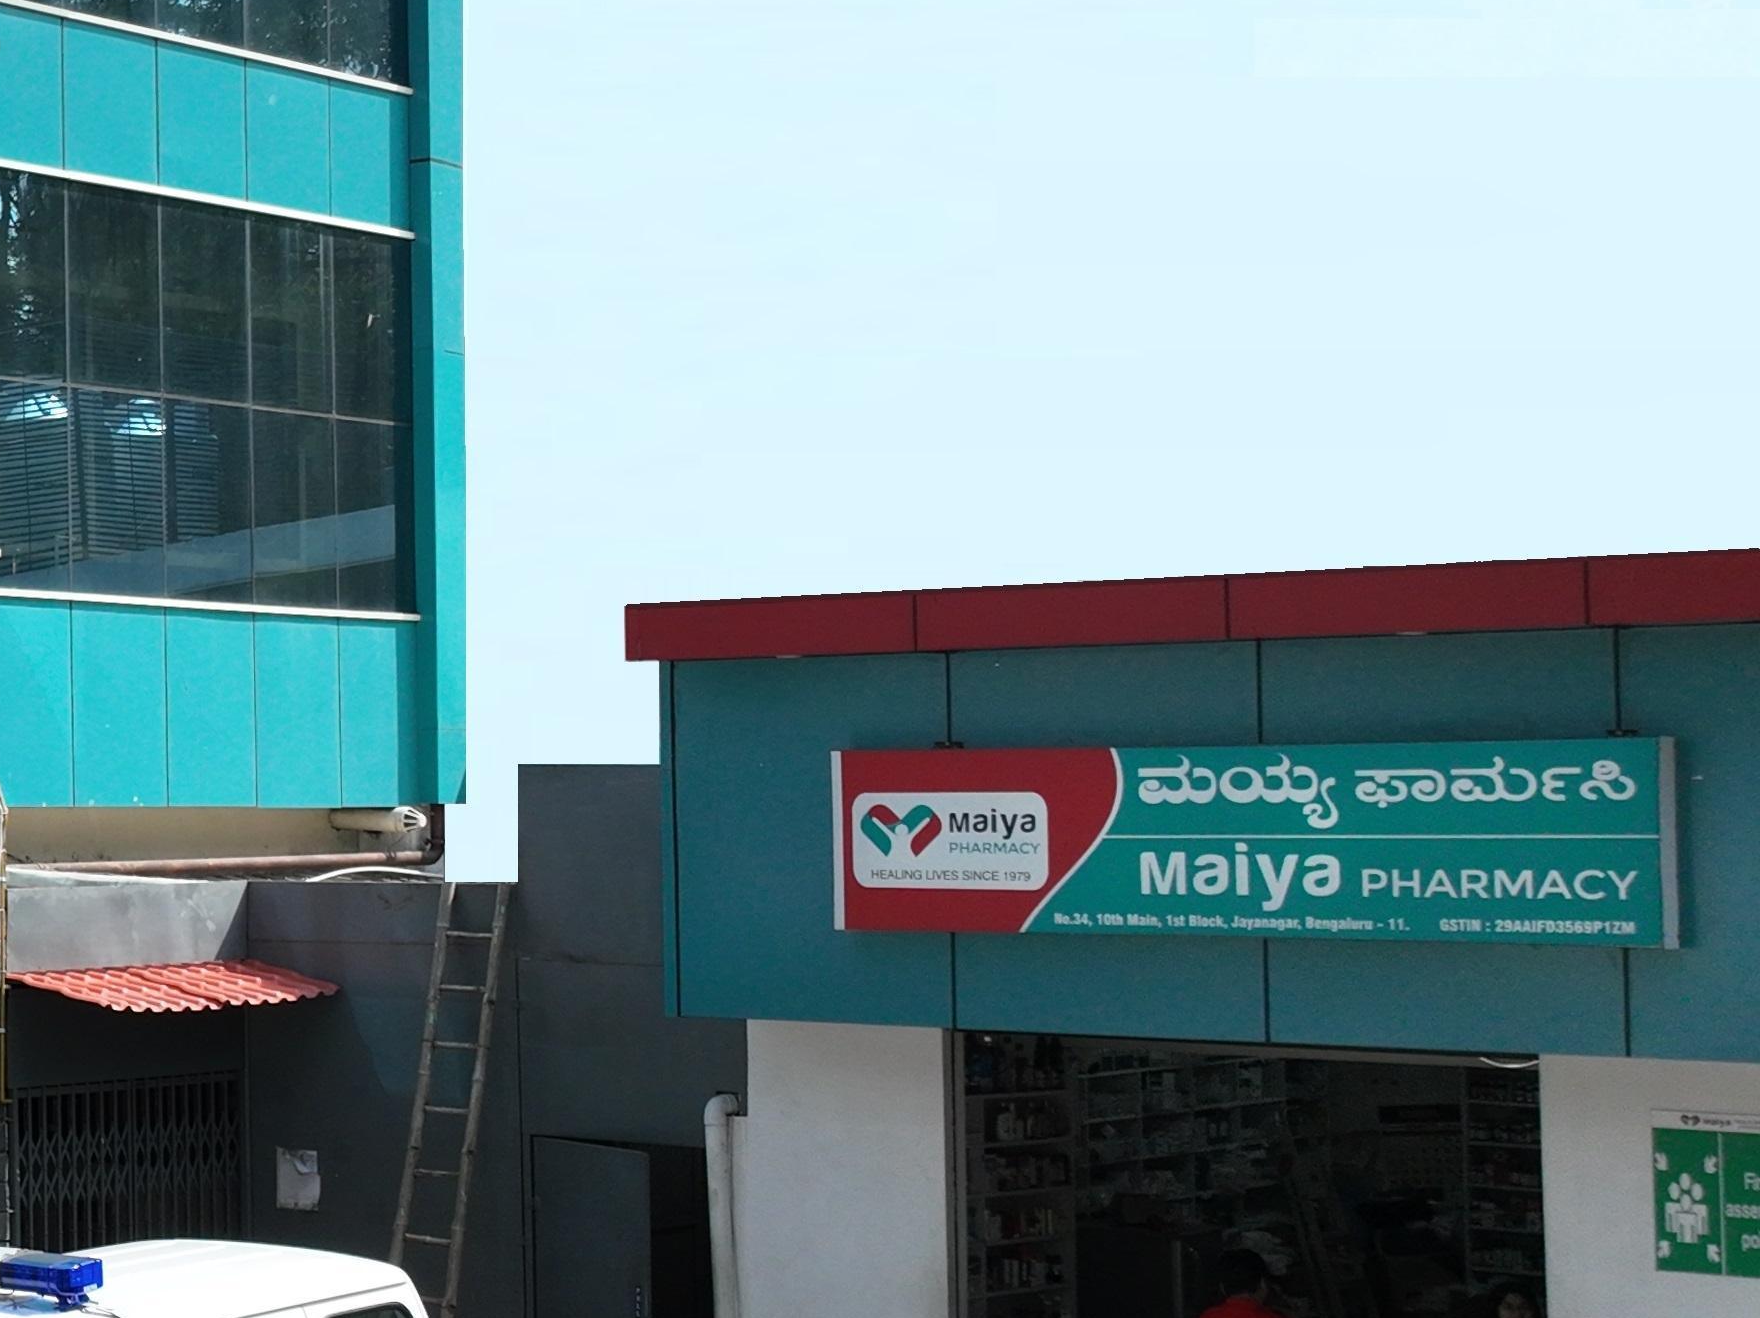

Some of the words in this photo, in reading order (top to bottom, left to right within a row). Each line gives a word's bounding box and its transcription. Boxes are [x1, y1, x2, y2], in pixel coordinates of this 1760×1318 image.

[1138, 753, 1338, 829] ಮಯ್ಯ
[949, 810, 1036, 839] Maiya
[949, 842, 1040, 855] PHARMACY
[871, 869, 923, 881] HEALING
[925, 870, 960, 881] LIVES
[962, 870, 999, 881] SINCE
[1003, 871, 1032, 882] 1979
[1139, 842, 1341, 912] Maiya
[1361, 868, 1637, 901] PHARMACY
[1054, 913, 1092, 927] No.34,
[1097, 914, 1124, 926] 10th
[1127, 914, 1162, 928] Main,
[1166, 915, 1185, 927] 1st
[1189, 915, 1228, 929] Block,
[1231, 916, 1302, 930] Jayanagar,
[1305, 916, 1373, 931] Bengaluru
[1440, 919, 1482, 932] GSTIN
[1495, 920, 1636, 934] 29AAIFD3569P1ZM
